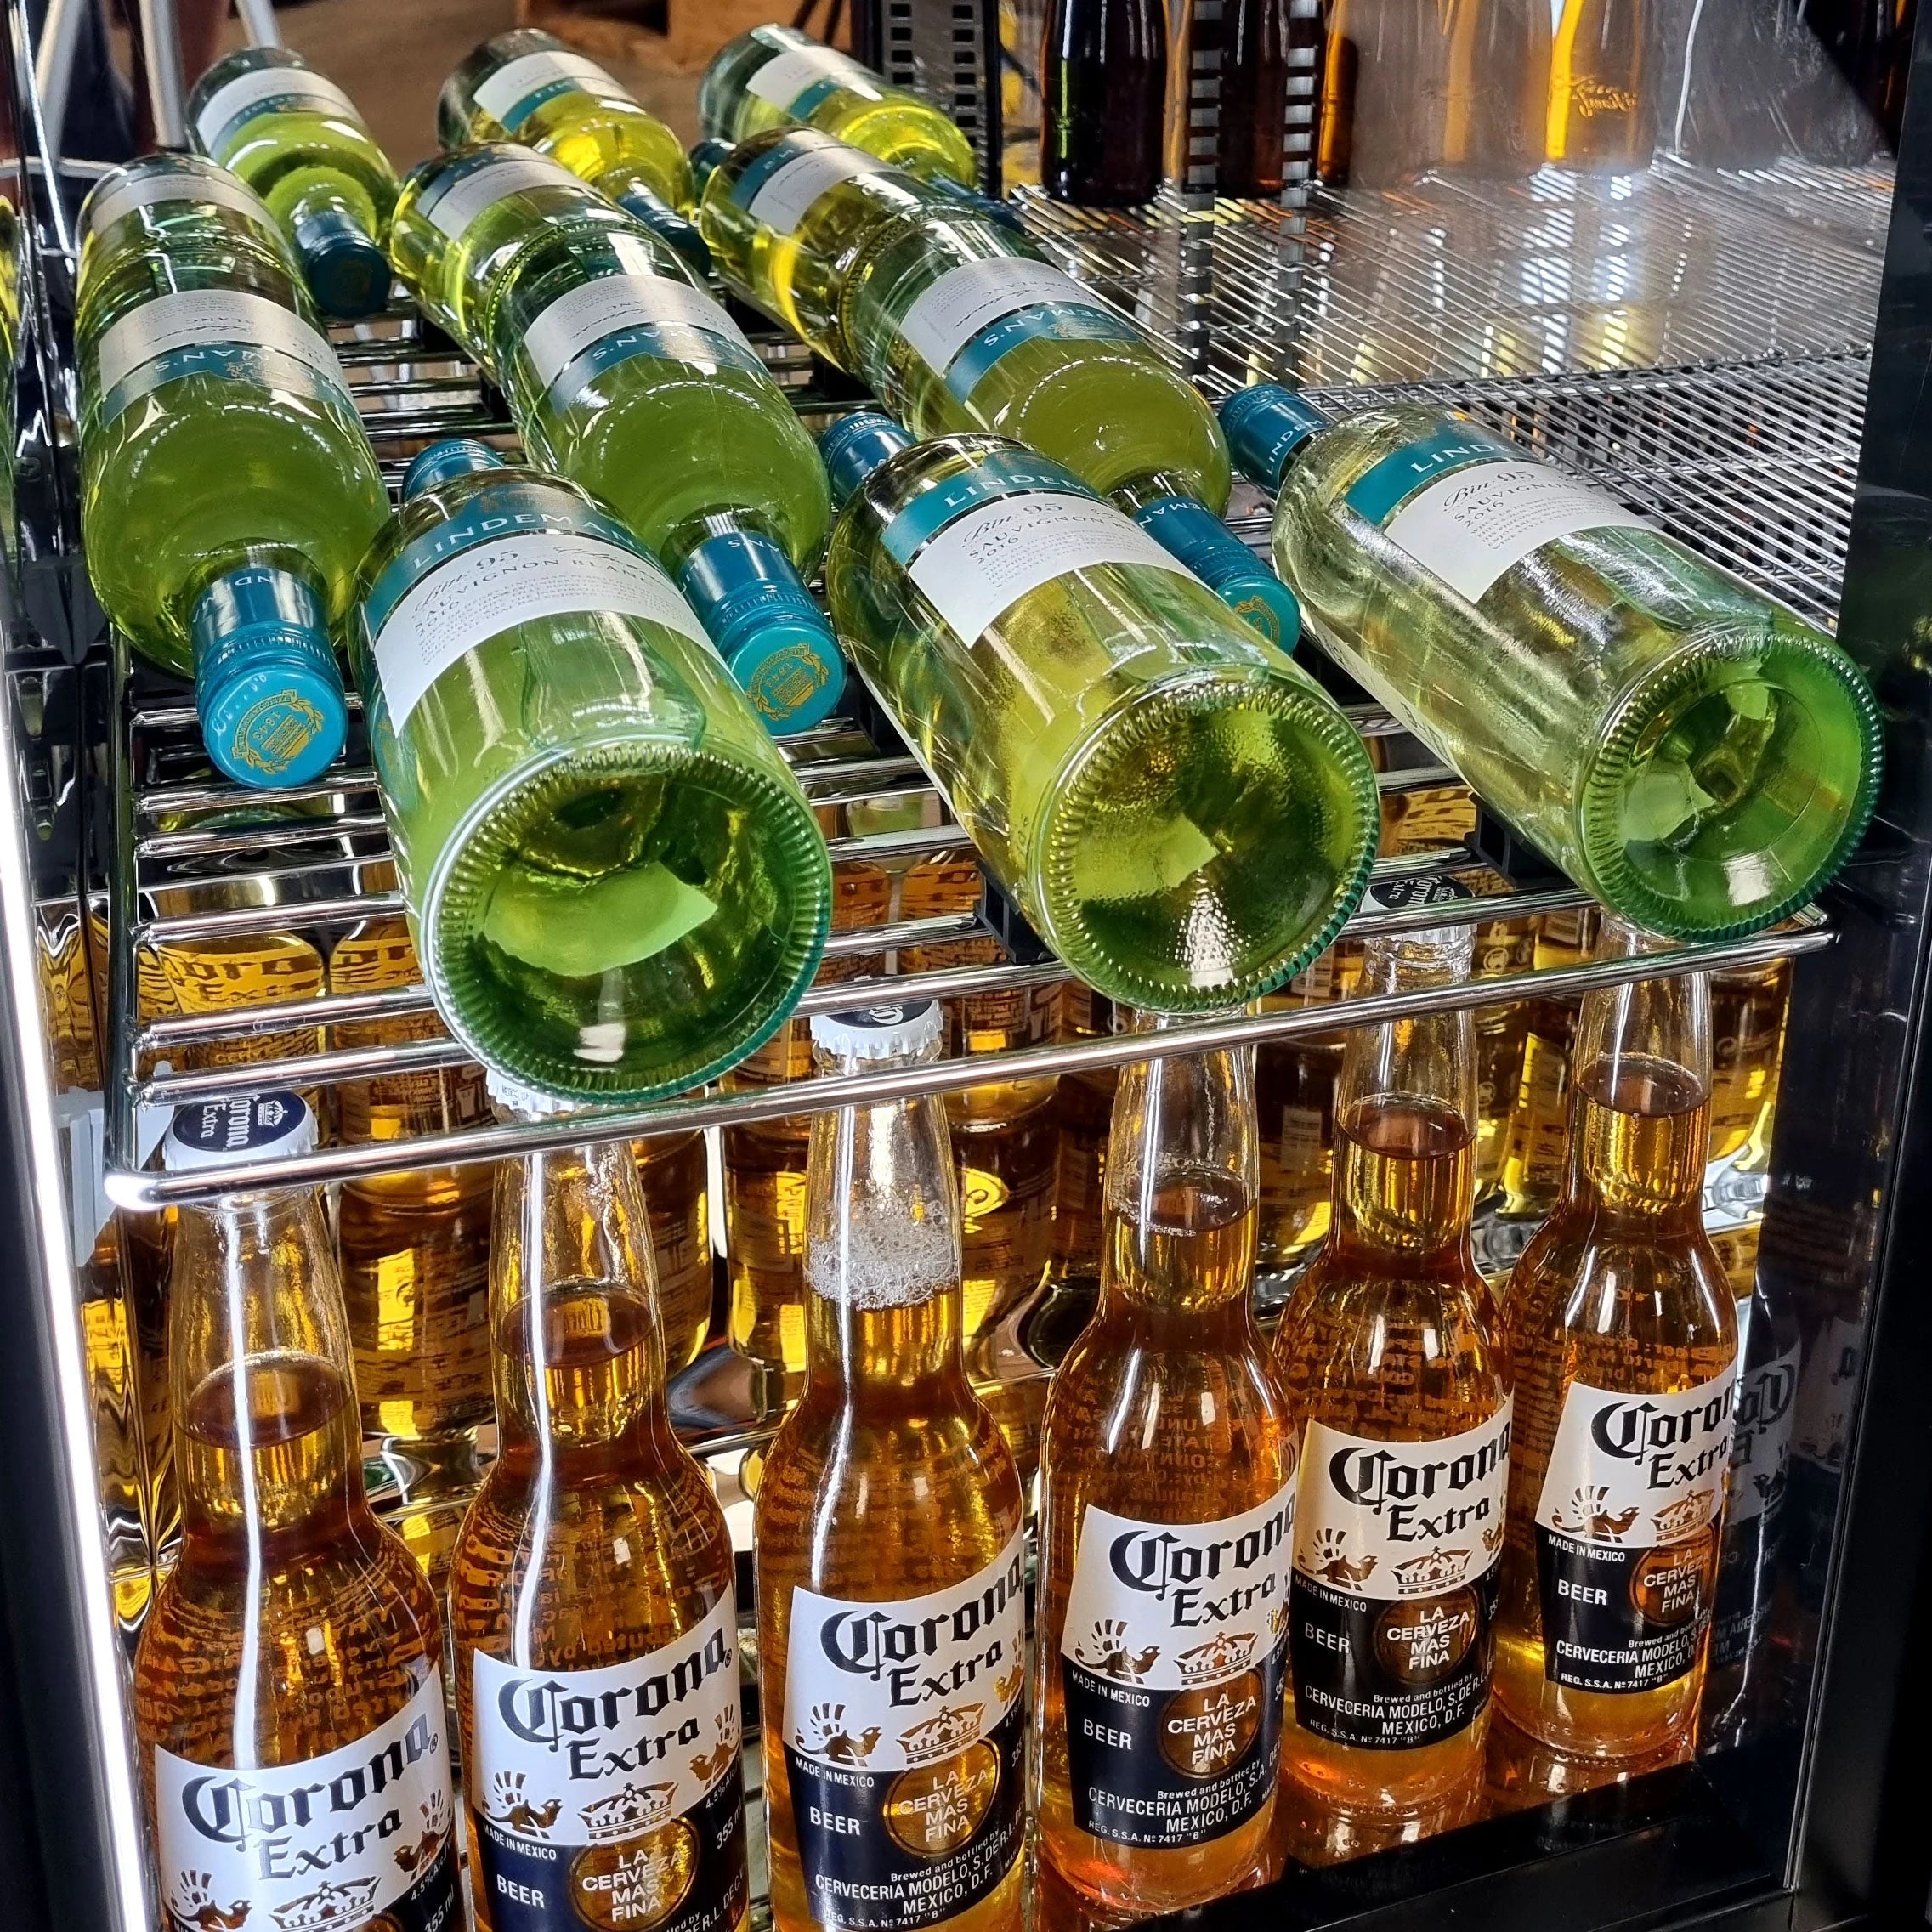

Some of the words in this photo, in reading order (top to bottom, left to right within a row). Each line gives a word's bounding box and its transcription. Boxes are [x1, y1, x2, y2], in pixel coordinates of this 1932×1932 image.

[1497, 471, 1536, 482] 95
[1023, 502, 1063, 515] 95
[1464, 501, 1504, 528] 2016
[477, 550, 519, 570] 95
[977, 537, 1019, 564] 2016
[1329, 1420, 1510, 1516] Corona
[1647, 1435, 1727, 1489] Extra
[1386, 1496, 1490, 1543] Extra
[1548, 1533, 1574, 1555] MADE
[1576, 1544, 1586, 1557] IN
[1586, 1547, 1626, 1563] MEXICO
[1674, 1548, 1693, 1566] LA
[1170, 1571, 1276, 1629] Extra
[1295, 1575, 1317, 1598] MADE
[1318, 1587, 1329, 1601] IN
[1329, 1592, 1367, 1613] MEXICO
[1557, 1578, 1608, 1606] BEER
[1663, 1574, 1696, 1599] MAS
[1419, 1606, 1445, 1623] LA
[1661, 1590, 1695, 1614] FINA
[820, 1552, 1022, 1682] Corona
[1386, 1610, 1470, 1642] CERVEZA
[1304, 1621, 1351, 1654] BEER
[1410, 1635, 1450, 1655] MAS
[1628, 1637, 1663, 1649] Brewed
[1408, 1649, 1450, 1670] FINA
[1556, 1640, 1639, 1665] CERVECERIA
[1635, 1652, 1686, 1679] MEXICO,
[889, 1639, 1003, 1708] Extra
[1561, 1672, 1582, 1686] REG.
[1626, 1678, 1650, 1690] 7417
[498, 1626, 726, 1752] Corona
[1072, 1669, 1096, 1693] MADE
[1097, 1681, 1108, 1698] IN
[1109, 1686, 1151, 1708] MEXICO
[1204, 1691, 1230, 1713] LA
[1305, 1684, 1385, 1720] CERVECERIA
[1388, 1694, 1446, 1720] MODELO,
[1373, 1691, 1413, 1703] Brewed
[1414, 1689, 1431, 1702] and
[1166, 1694, 1256, 1735] CERVEZA
[1381, 1713, 1442, 1735] MEXICO,
[1083, 1717, 1133, 1751] BEER
[1193, 1725, 1237, 1748] MAS
[1309, 1719, 1329, 1735] REG.
[1374, 1735, 1397, 1745] 7417
[569, 1715, 700, 1781] Extra
[1191, 1738, 1237, 1765] FINA
[182, 1713, 430, 1852] Corona
[796, 1756, 821, 1779] MADE
[822, 1768, 833, 1783] IN
[834, 1771, 875, 1789] MEXICO
[932, 1768, 960, 1791] LA
[1156, 1785, 1198, 1800] Brewed
[1198, 1778, 1218, 1794] and
[1219, 1764, 1250, 1791] bottled
[898, 1769, 989, 1816] CERVEZA
[1088, 1786, 1183, 1816] CERVECERIA
[1186, 1776, 1247, 1815] MODELO,
[809, 1805, 861, 1836] BEER
[926, 1797, 969, 1827] MAS
[1165, 1806, 1228, 1834] MEXICO,
[258, 1807, 403, 1881] Extra
[483, 1822, 505, 1848] MADE
[506, 1836, 516, 1852] IN
[516, 1842, 557, 1861] MEXICO
[717, 1815, 734, 1850] 355
[925, 1815, 971, 1844] FINA
[1088, 1819, 1109, 1835] REG.
[1111, 1827, 1142, 1842] S.S.A.
[1158, 1833, 1183, 1844] 7417
[581, 1850, 681, 1892] CERVEZA
[618, 1849, 649, 1870] LA
[891, 1867, 932, 1884] Brewed
[934, 1857, 954, 1873] and
[496, 1873, 545, 1909] BEER
[611, 1878, 660, 1905] MAS
[815, 1873, 905, 1901] CERVECERIA
[909, 1862, 972, 1897] MODELO,
[611, 1895, 661, 1924] FINA
[903, 1884, 968, 1916] MEXICO,
[848, 1916, 879, 1929] S.S.A.
[896, 1913, 921, 1927] 7417
